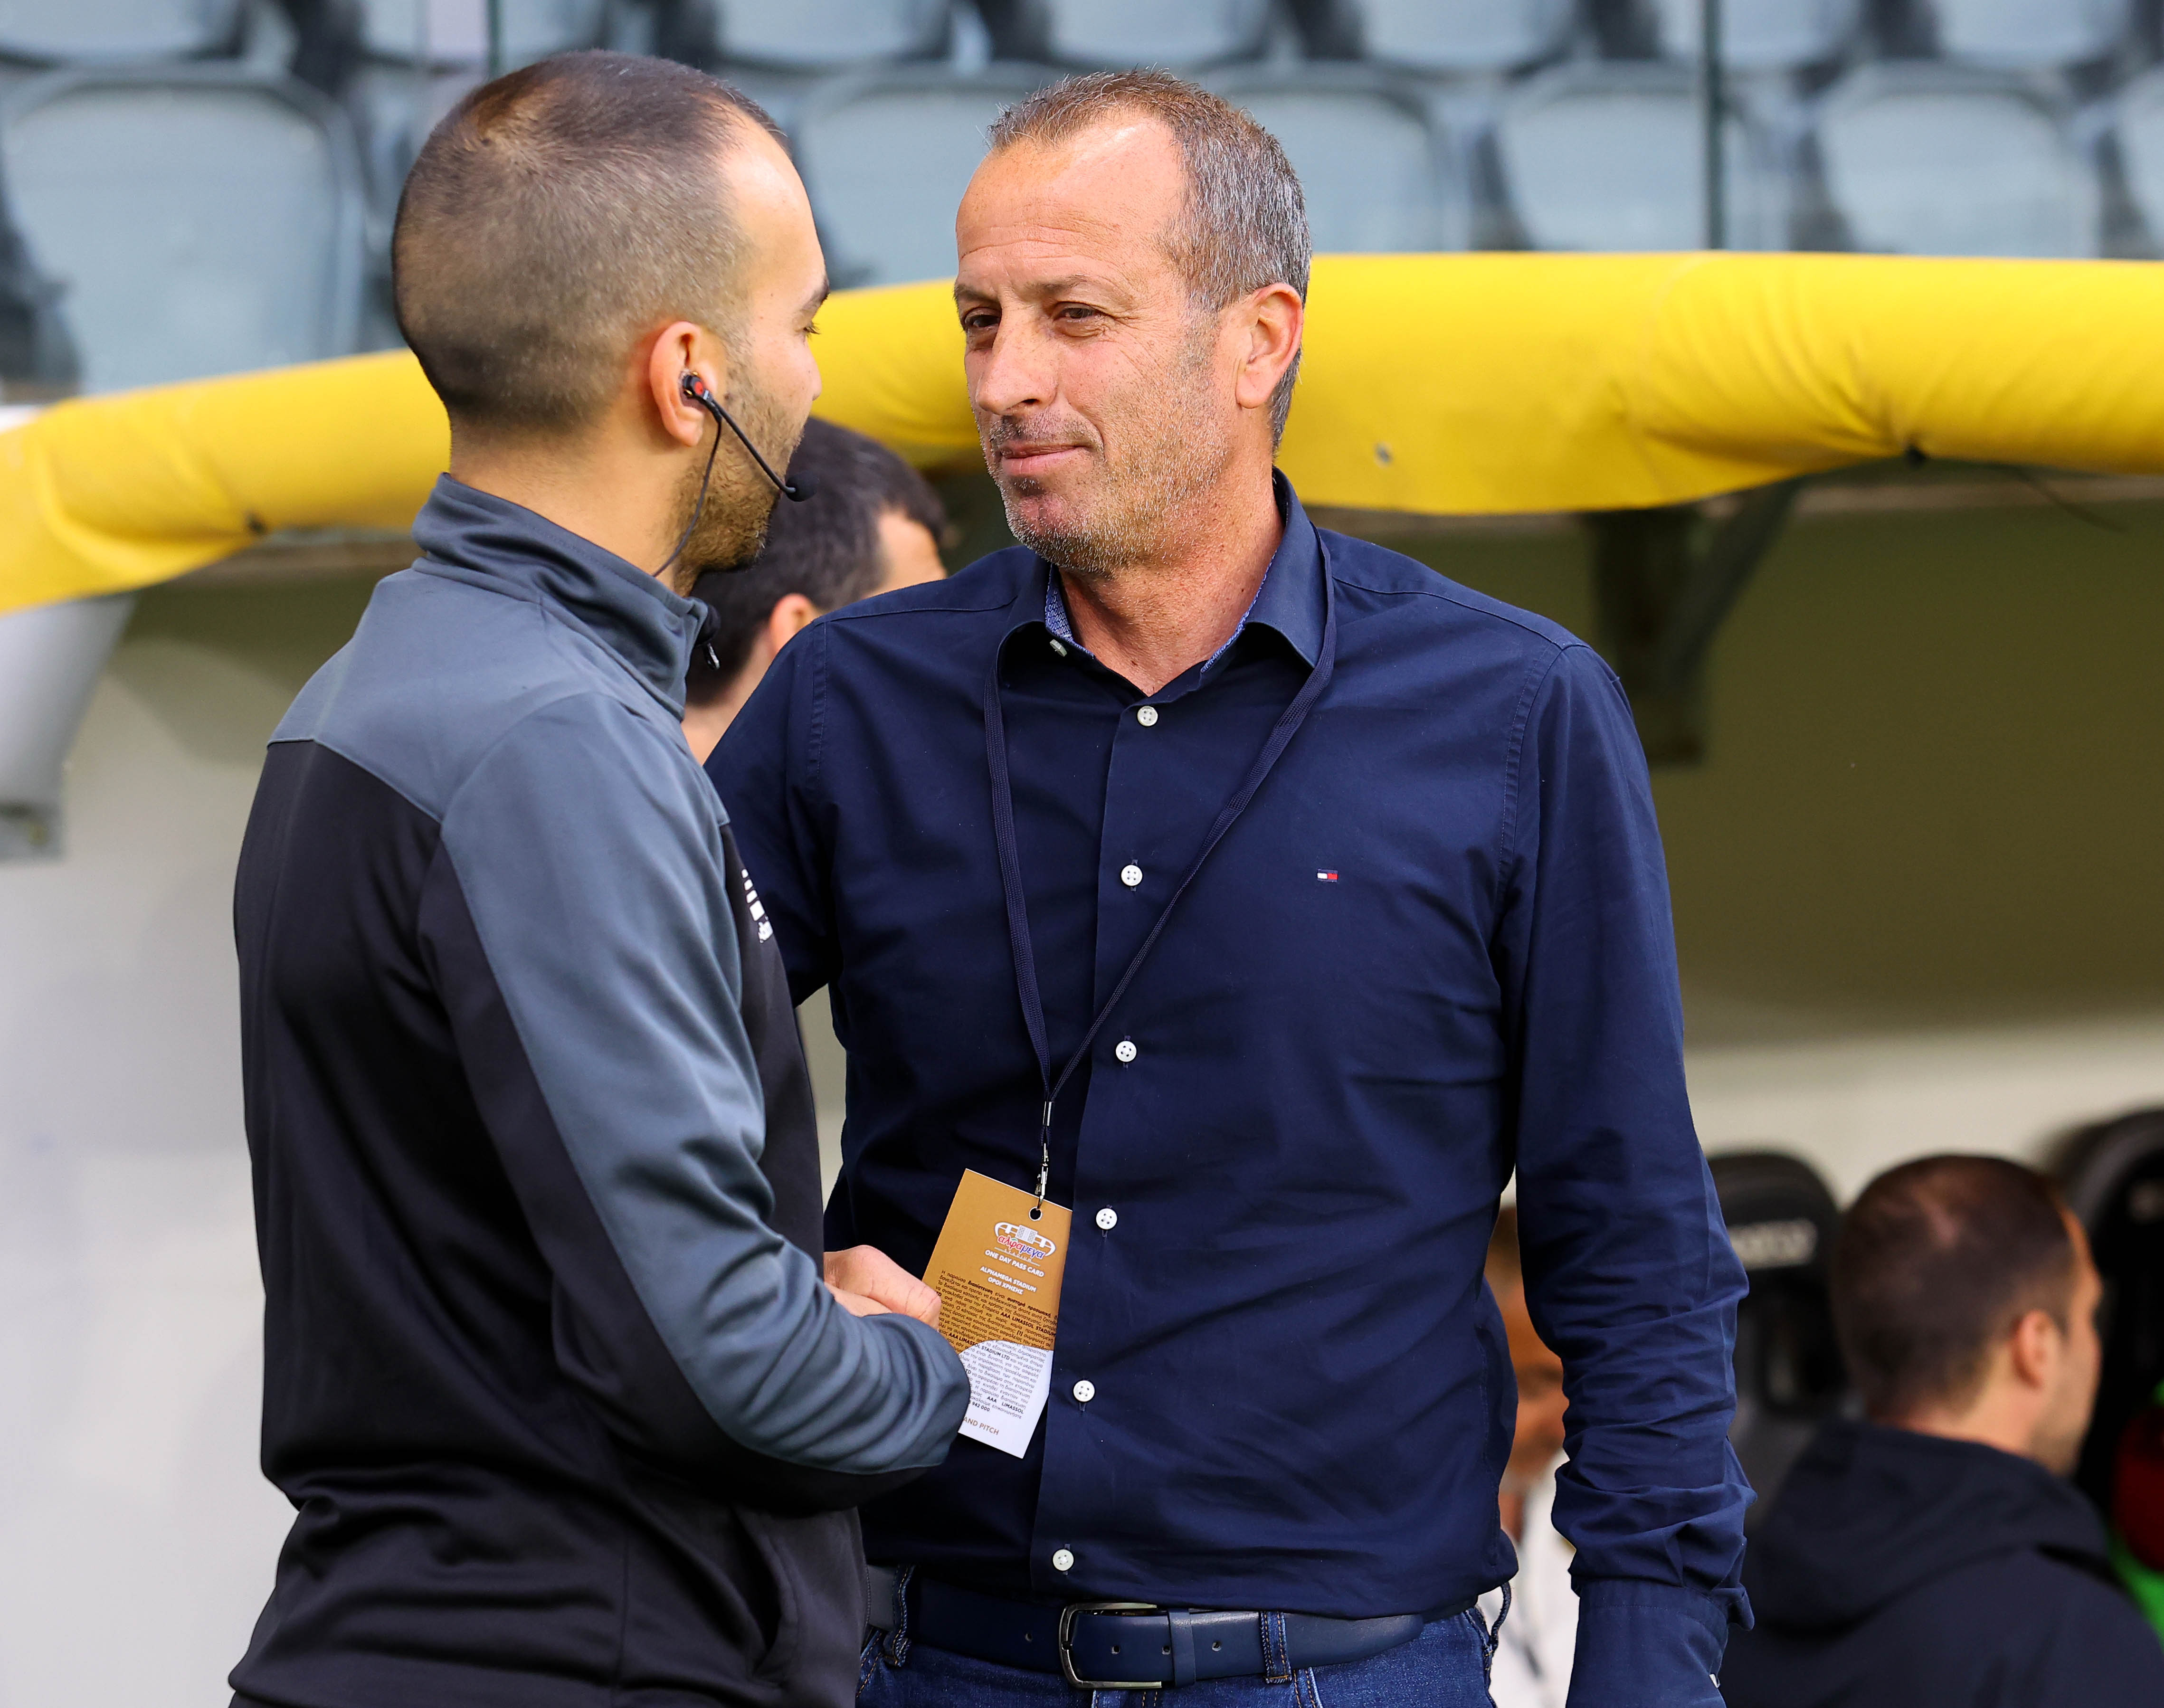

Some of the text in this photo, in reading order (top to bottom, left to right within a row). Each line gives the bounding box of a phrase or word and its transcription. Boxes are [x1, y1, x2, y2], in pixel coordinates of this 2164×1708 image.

[984, 1249, 1045, 1278] ONE DAY PASS CARD
[947, 1272, 966, 1283] παρούσα
[967, 1280, 993, 1294] διαπίστευση
[980, 1265, 1037, 1292] ALPHAMEGA STADIUM
[987, 1276, 1024, 1295] ΟΡΟΙ ΧΡΗΣΗΣ
[1011, 1316, 1035, 1328] LIMASSOL
[1035, 1325, 1056, 1337] STADIUM
[959, 1336, 981, 1348] LIMASSOL
[981, 1345, 1001, 1357] STADIUM
[1001, 1401, 1025, 1414] LIMASSOL
[979, 1422, 999, 1435] PITCH
